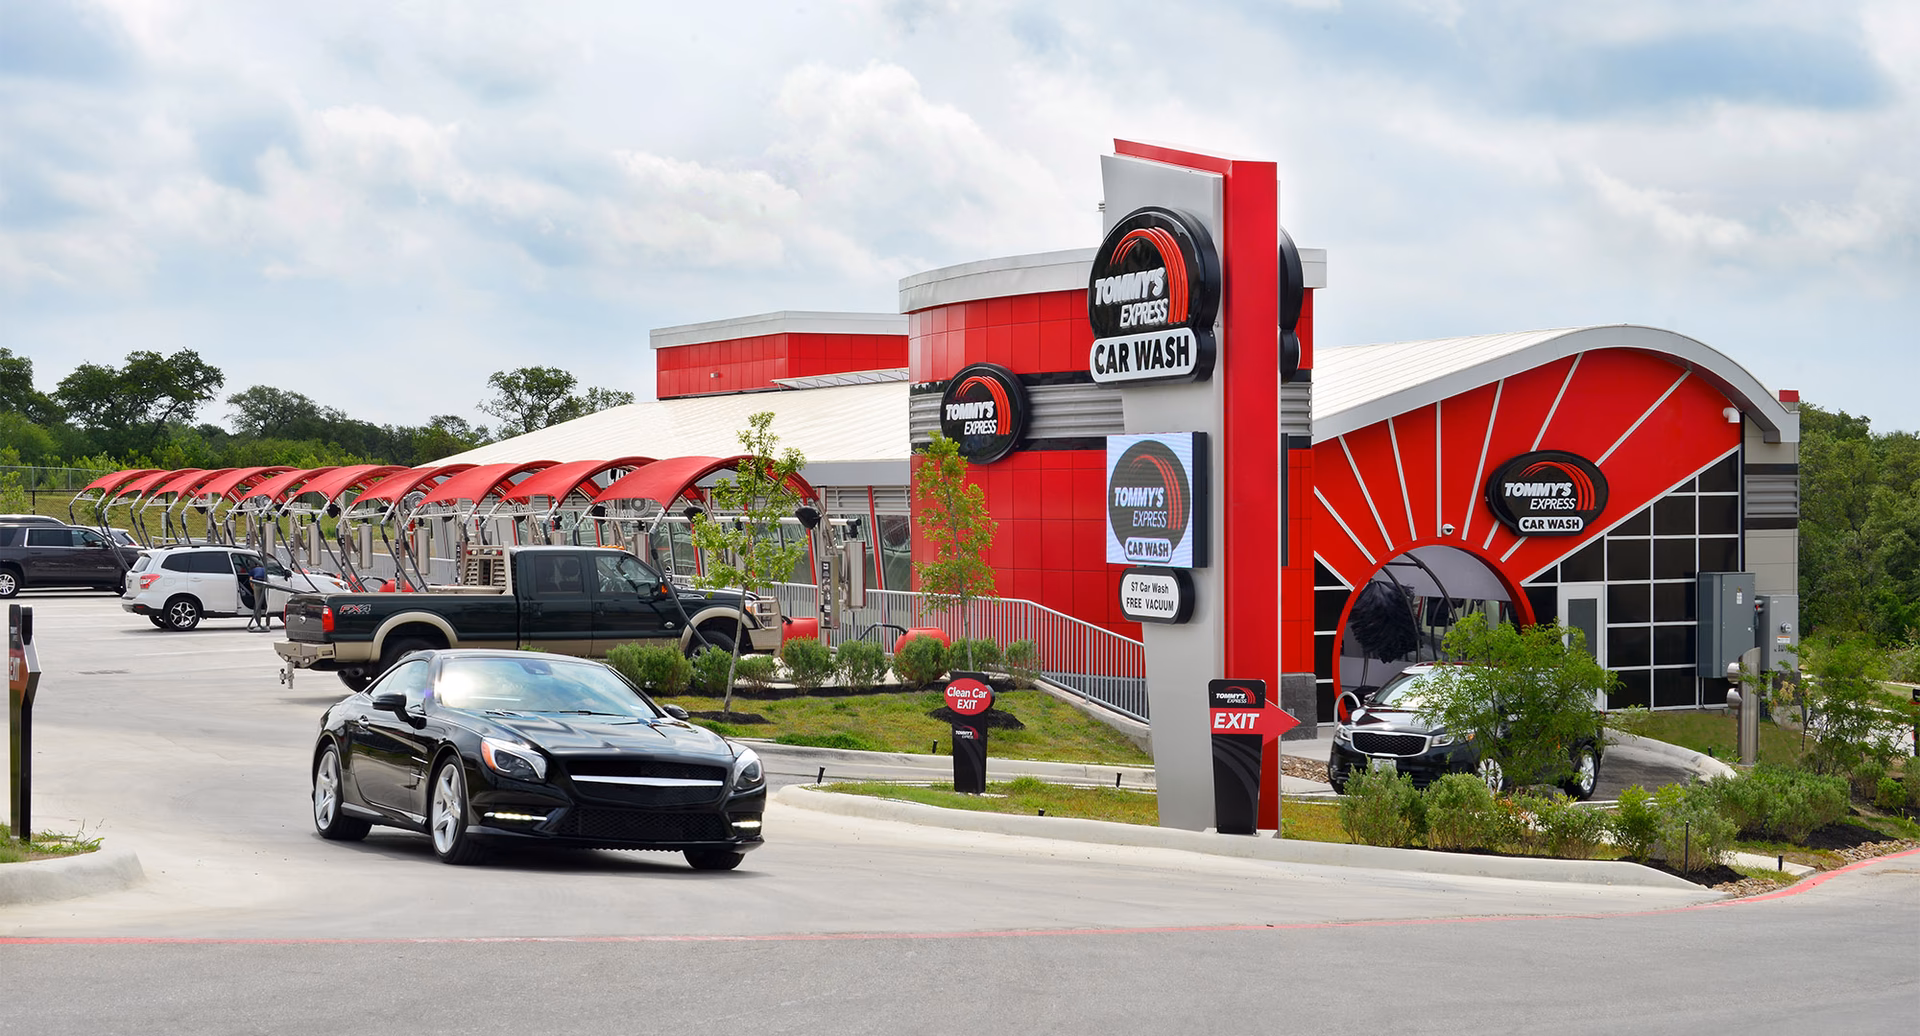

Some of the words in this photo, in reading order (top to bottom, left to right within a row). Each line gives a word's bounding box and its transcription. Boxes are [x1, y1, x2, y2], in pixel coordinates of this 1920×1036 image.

[1094, 267, 1166, 306] TOMMY'S
[1120, 298, 1168, 328] EXPRESS
[1094, 344, 1129, 375] CAR
[1134, 335, 1190, 370] WASH
[945, 401, 995, 420] TOMMY'S
[964, 420, 997, 435] EXPRESS
[1114, 486, 1165, 508] TOMMY'S
[1504, 482, 1573, 497] TOMMY'S
[1530, 498, 1576, 510] EXPRESS
[1132, 510, 1168, 529] EXPRESS
[1522, 519, 1545, 529] CAR
[1547, 519, 1580, 529] WASH
[1127, 541, 1144, 556] CAR
[1145, 542, 1169, 557] WASH
[1139, 582, 1151, 593] Car
[1152, 582, 1169, 594] Wash
[340, 604, 372, 613] FX4
[1126, 597, 1142, 608] FREE
[1145, 598, 1174, 611] VACUUM
[947, 686, 970, 698] Clean
[972, 688, 987, 699] Car
[957, 699, 977, 709] EXIT
[1213, 712, 1260, 729] EXIT
